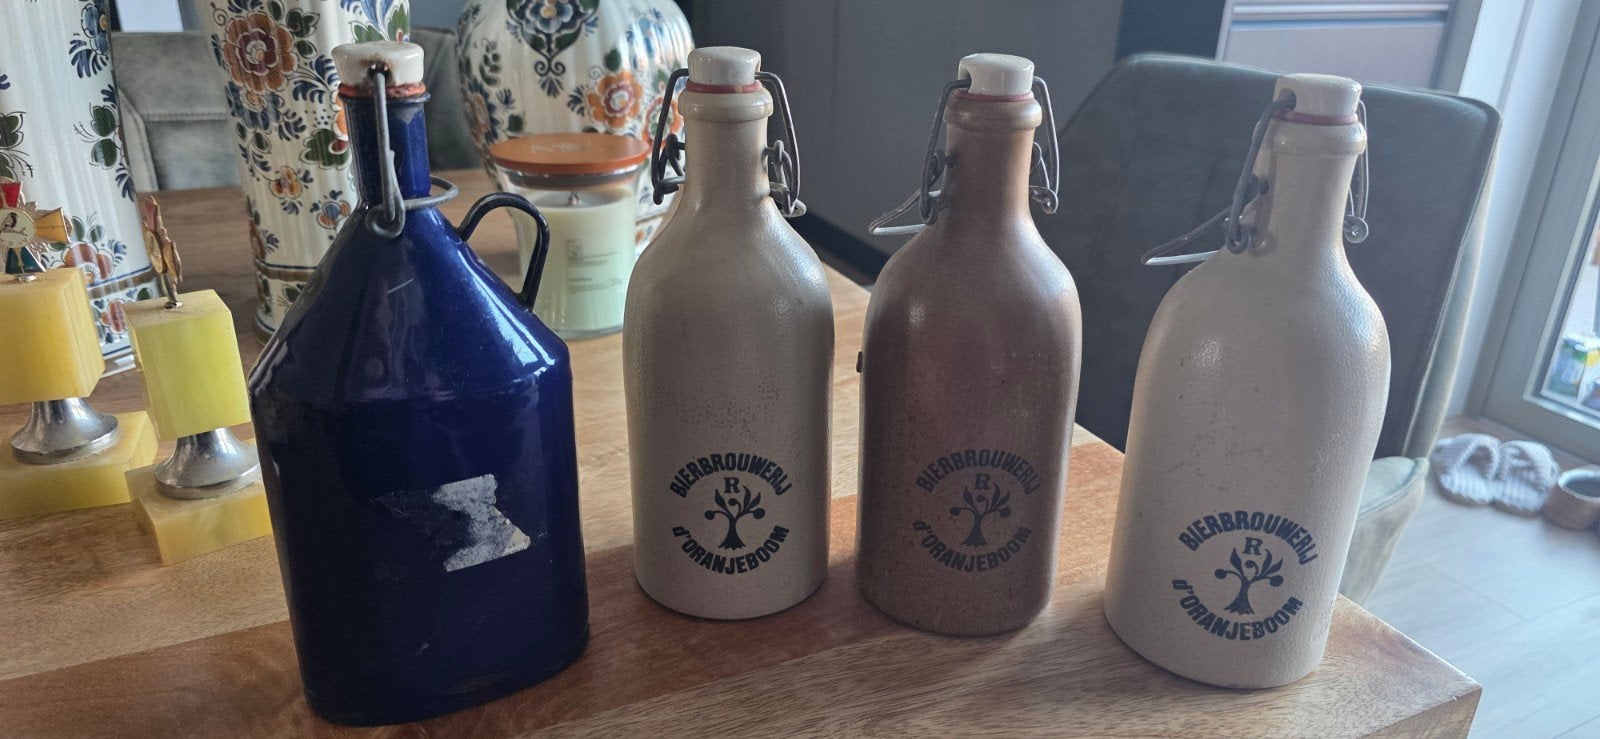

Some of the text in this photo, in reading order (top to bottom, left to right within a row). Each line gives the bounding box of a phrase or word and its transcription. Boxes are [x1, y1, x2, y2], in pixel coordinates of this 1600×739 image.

[669, 452, 793, 498] BIERBROUWERIJ
[723, 476, 741, 494] R
[915, 449, 1041, 496] BIERBROUWERIJ
[975, 473, 991, 490] R
[672, 525, 790, 575] d'ORANJEBOOM
[912, 520, 1033, 573] d'ORANJEBOOM
[1178, 510, 1319, 566] BIERBROUWERIJ
[1242, 536, 1263, 556] R
[1172, 579, 1304, 641] d'ORANJEBOOM
